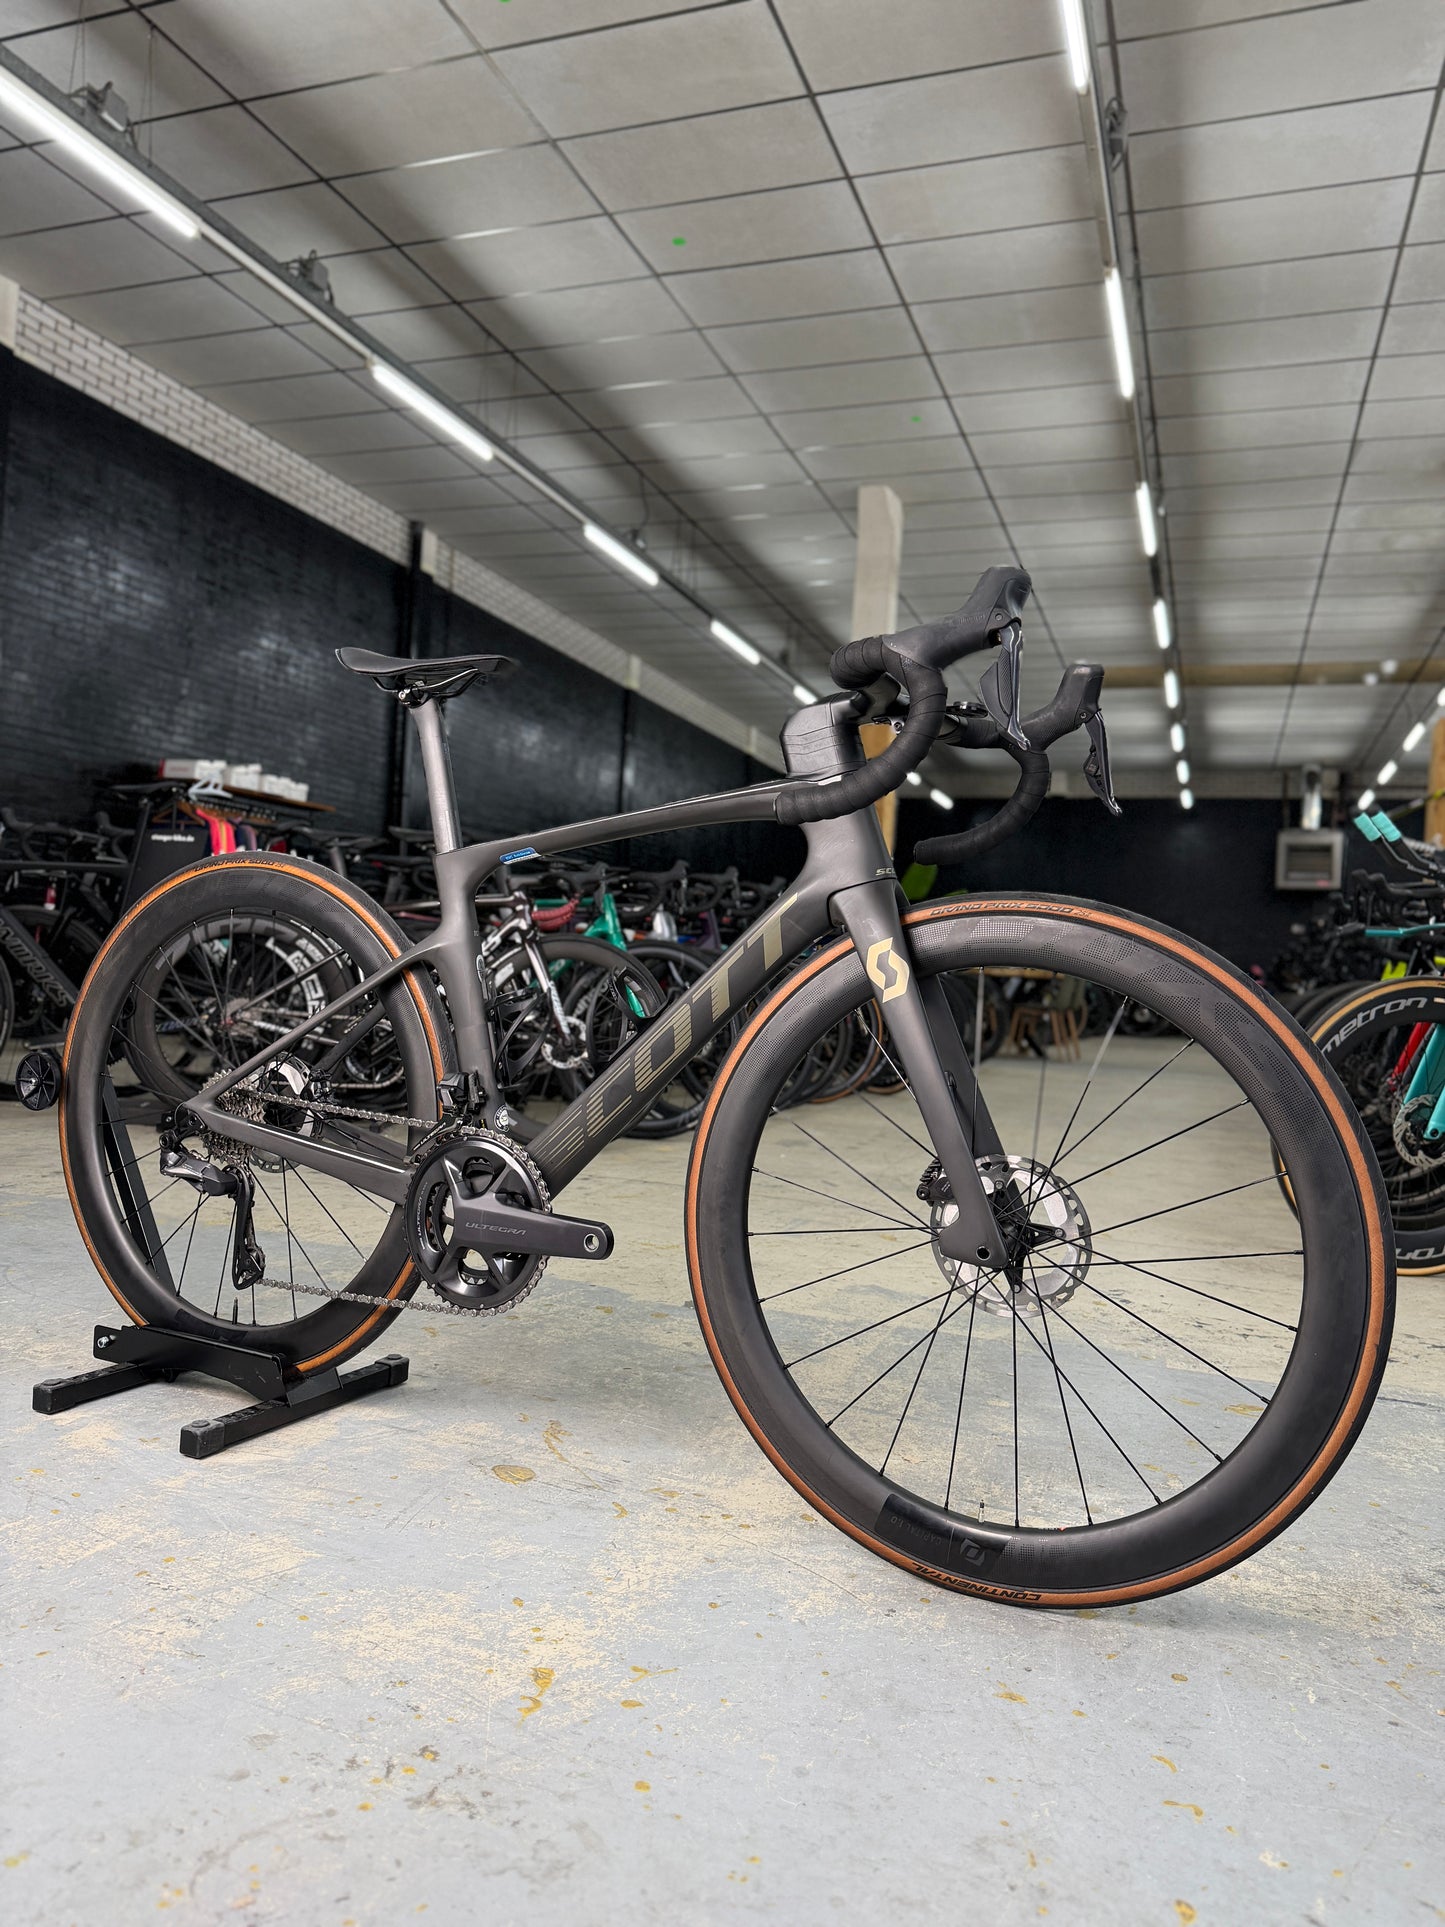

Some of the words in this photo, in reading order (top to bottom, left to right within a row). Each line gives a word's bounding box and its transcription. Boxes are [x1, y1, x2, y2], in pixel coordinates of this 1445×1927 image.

[929, 902, 982, 916] GRAND
[983, 901, 1023, 909] PRIX
[1024, 903, 1074, 914] 5000
[529, 893, 798, 1172] SCOTT
[465, 1221, 527, 1236] ULTEGRA
[912, 1562, 1042, 1601] CONTINENTAL
